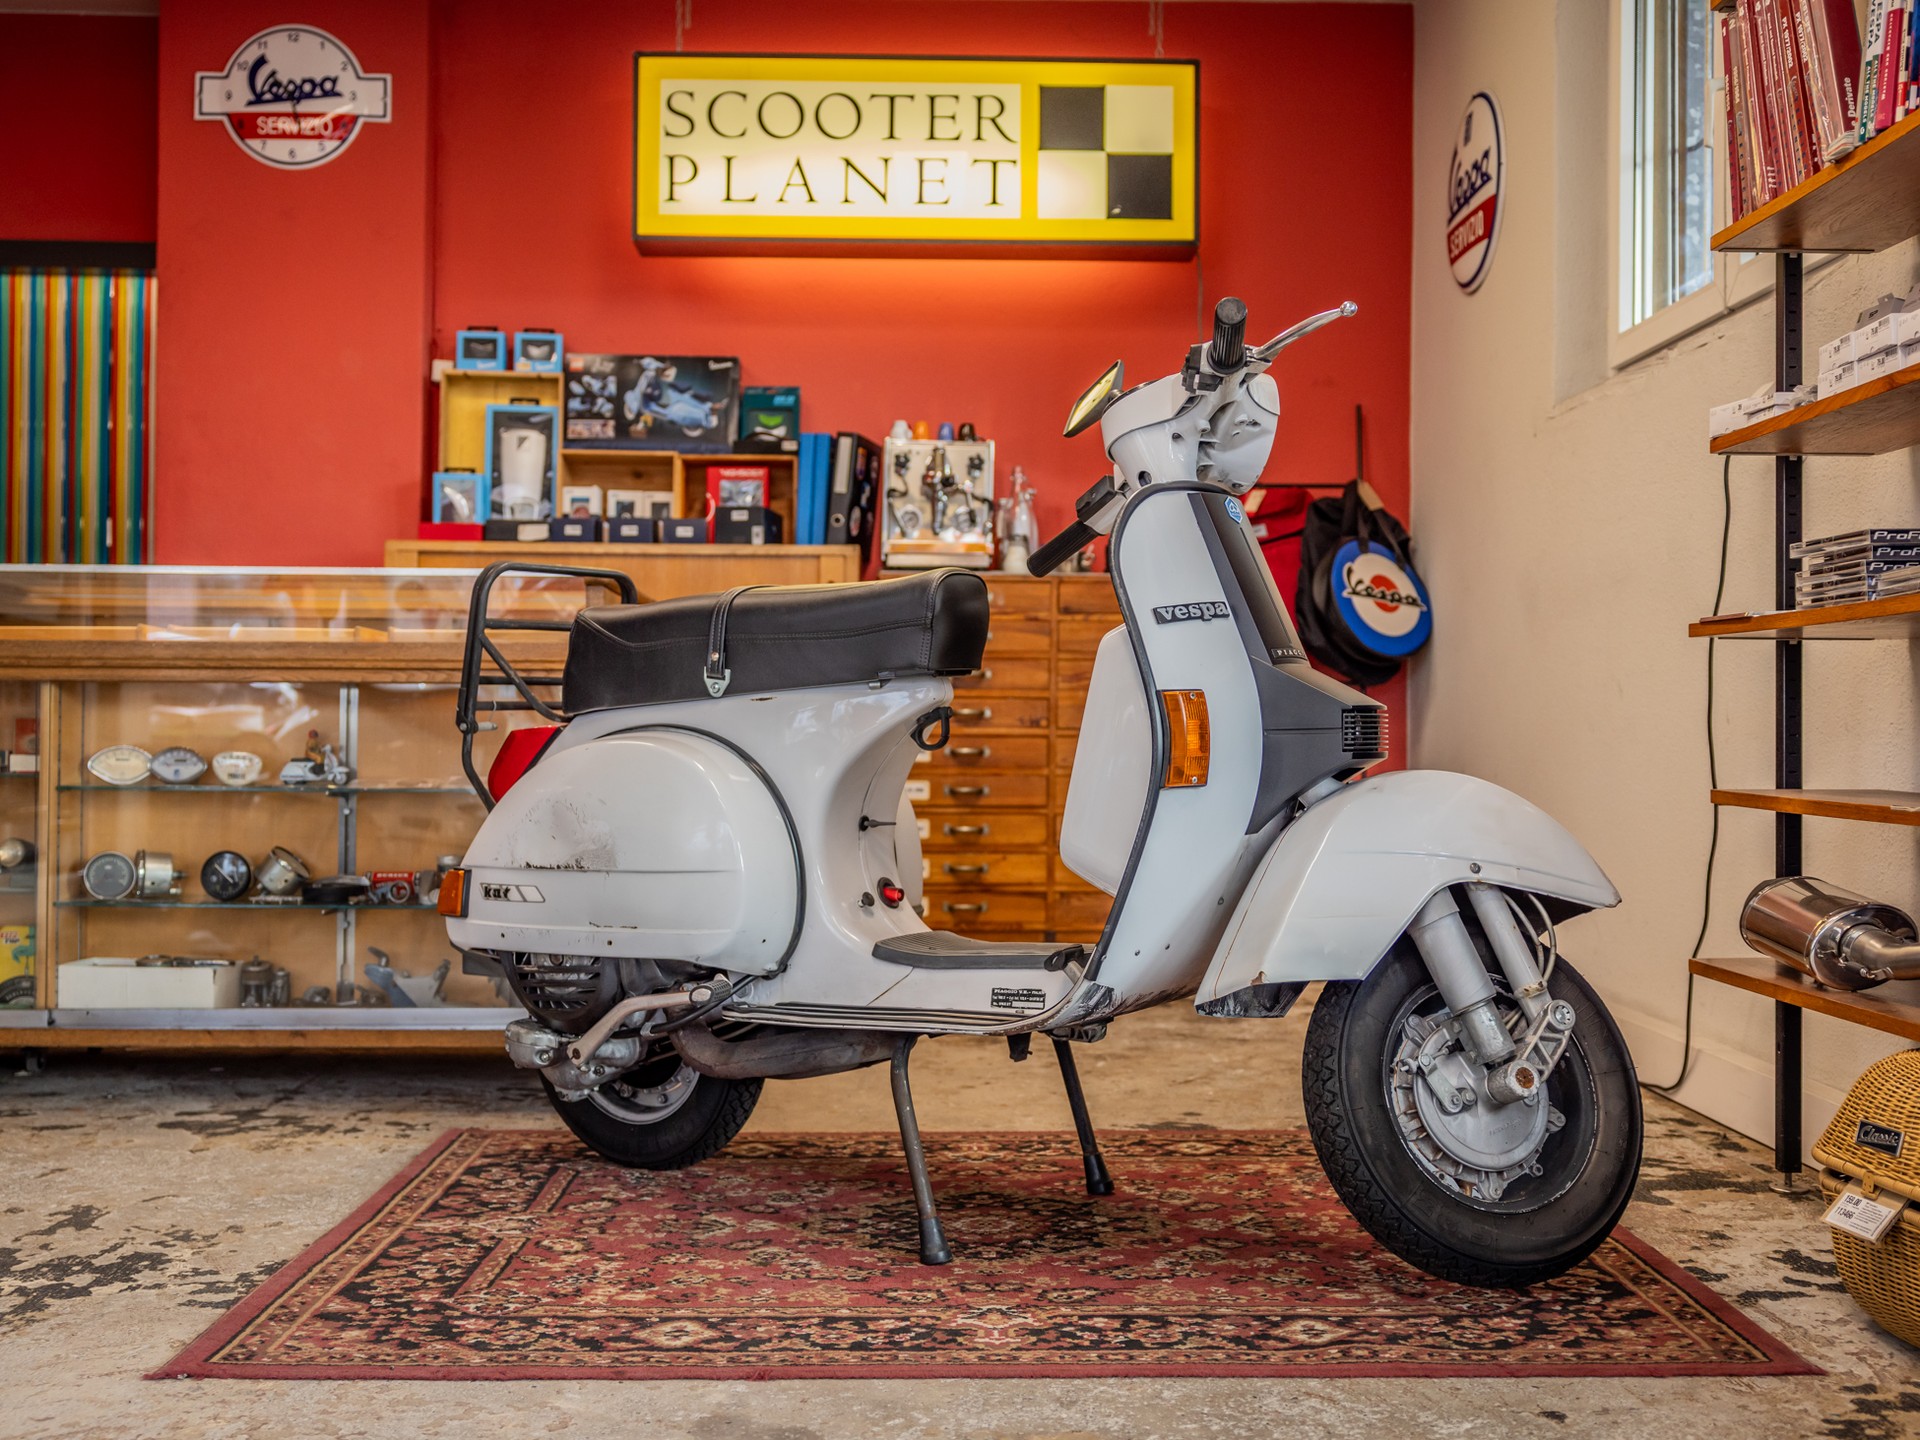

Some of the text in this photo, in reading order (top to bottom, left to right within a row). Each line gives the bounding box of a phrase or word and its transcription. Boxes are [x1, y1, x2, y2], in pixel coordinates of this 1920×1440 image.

[1729, 18, 1736, 30] 2
[245, 53, 344, 107] Vespa
[1843, 76, 1856, 118] Derivate
[256, 115, 334, 137] SERVIZIO
[664, 89, 1019, 144] SCOOTER
[664, 153, 1018, 207] PLANET
[1873, 530, 1920, 540] ProF
[1345, 564, 1425, 609] Vespa
[1156, 602, 1230, 621] vespa
[1860, 1125, 1899, 1146] Classic
